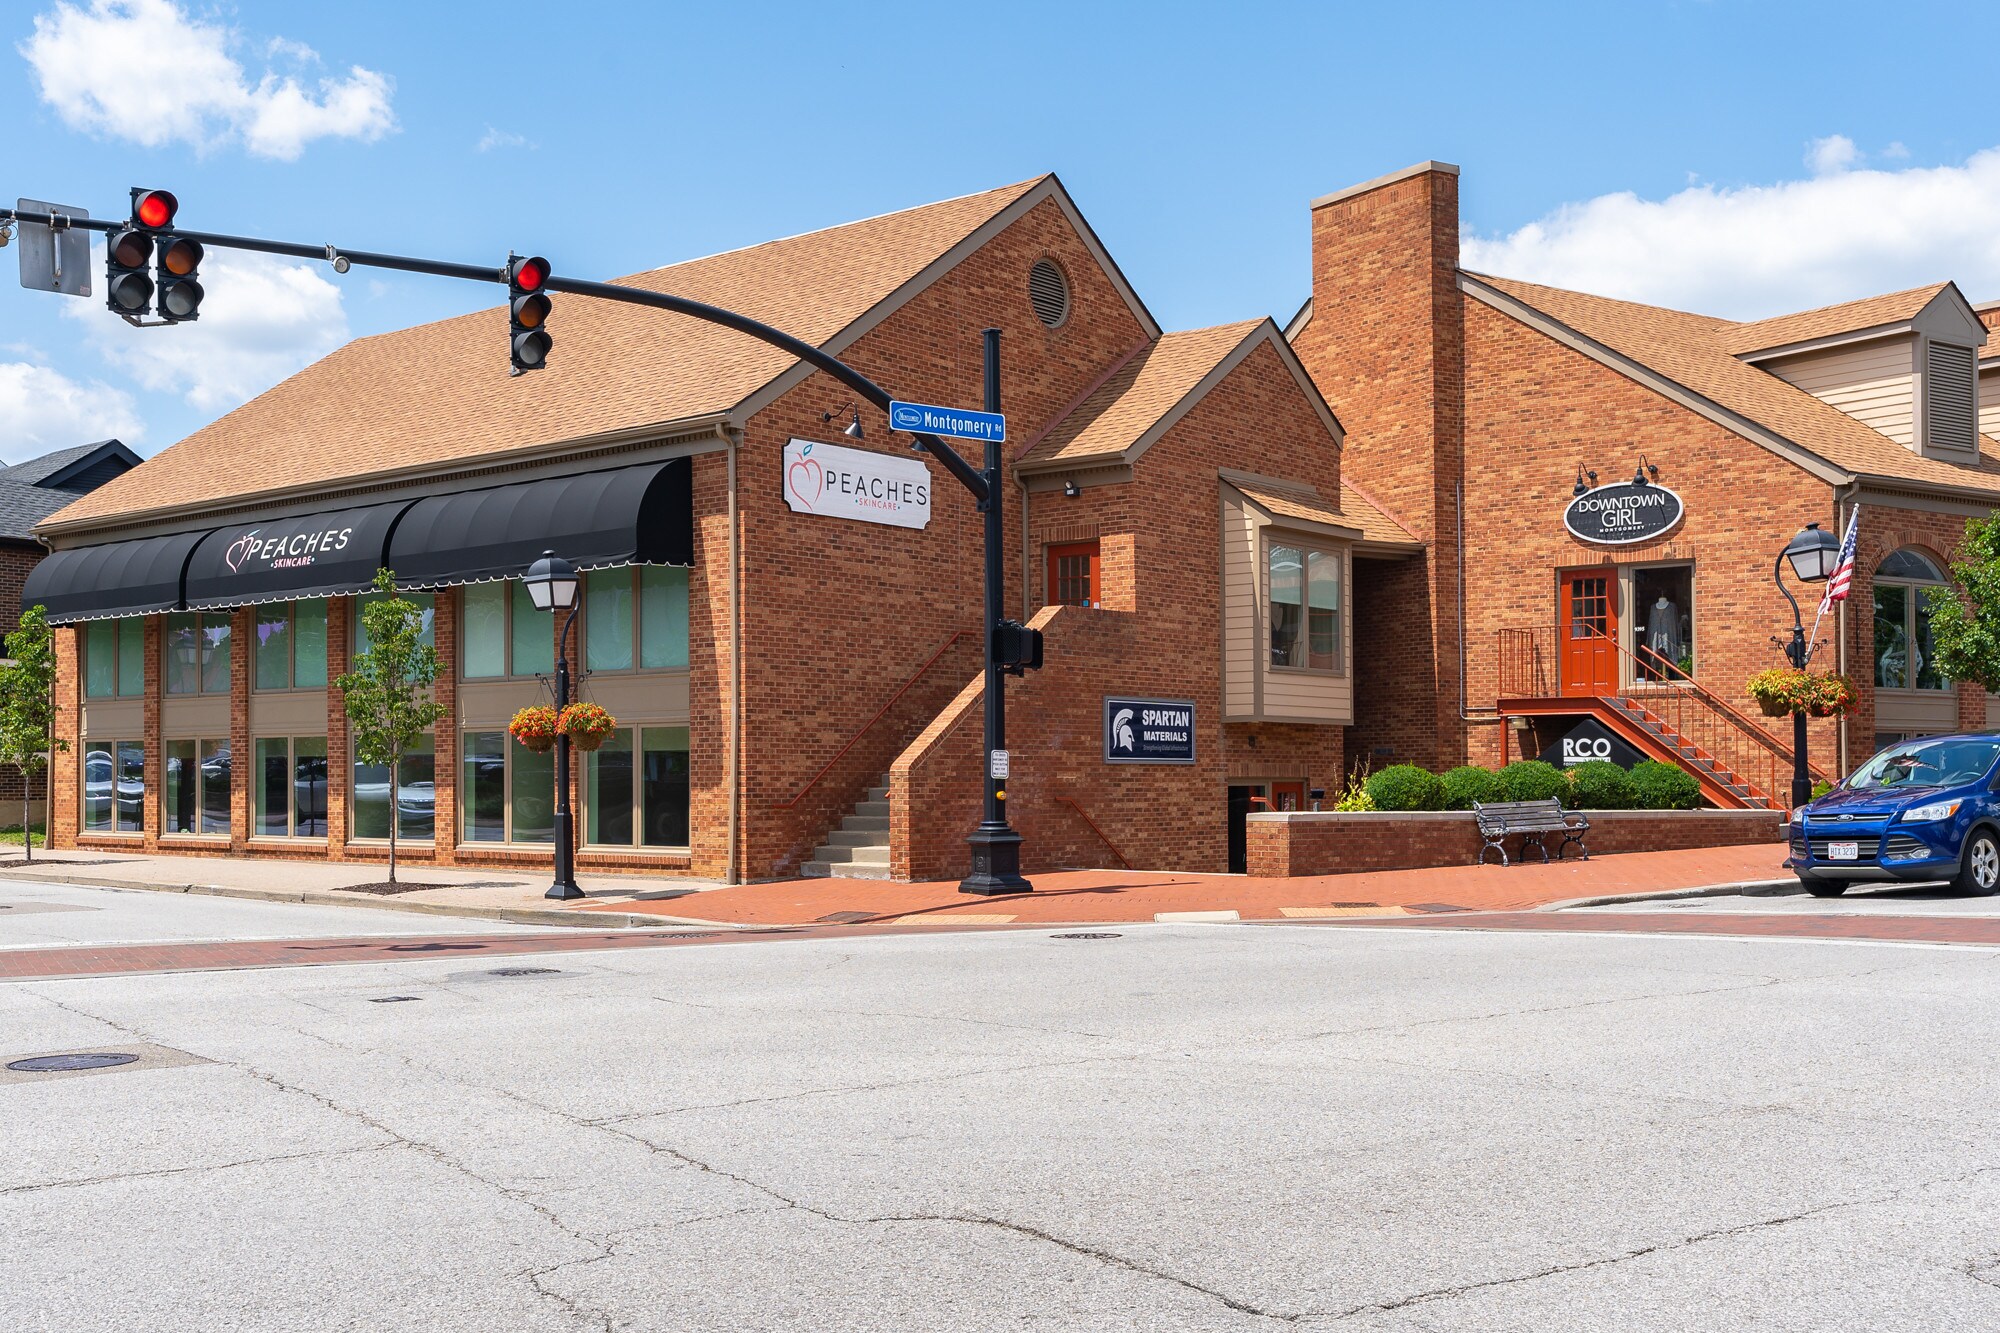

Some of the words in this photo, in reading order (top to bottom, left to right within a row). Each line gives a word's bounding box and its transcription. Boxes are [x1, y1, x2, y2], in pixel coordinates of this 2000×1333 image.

[924, 412, 992, 437] Montgomery
[994, 424, 1002, 433] Rd
[826, 470, 927, 506] PEACHES
[859, 497, 897, 511] SKINCARE
[1578, 493, 1665, 513] DOWNTOWN
[1601, 508, 1643, 527] GIRL
[1599, 525, 1645, 533] MONTGOMERY
[247, 528, 352, 560] PEACHES
[273, 556, 312, 568] SKINCARE
[1142, 709, 1189, 727] SPARTAN
[1143, 731, 1188, 742] MATERIALS
[1562, 738, 1611, 757] RCO
